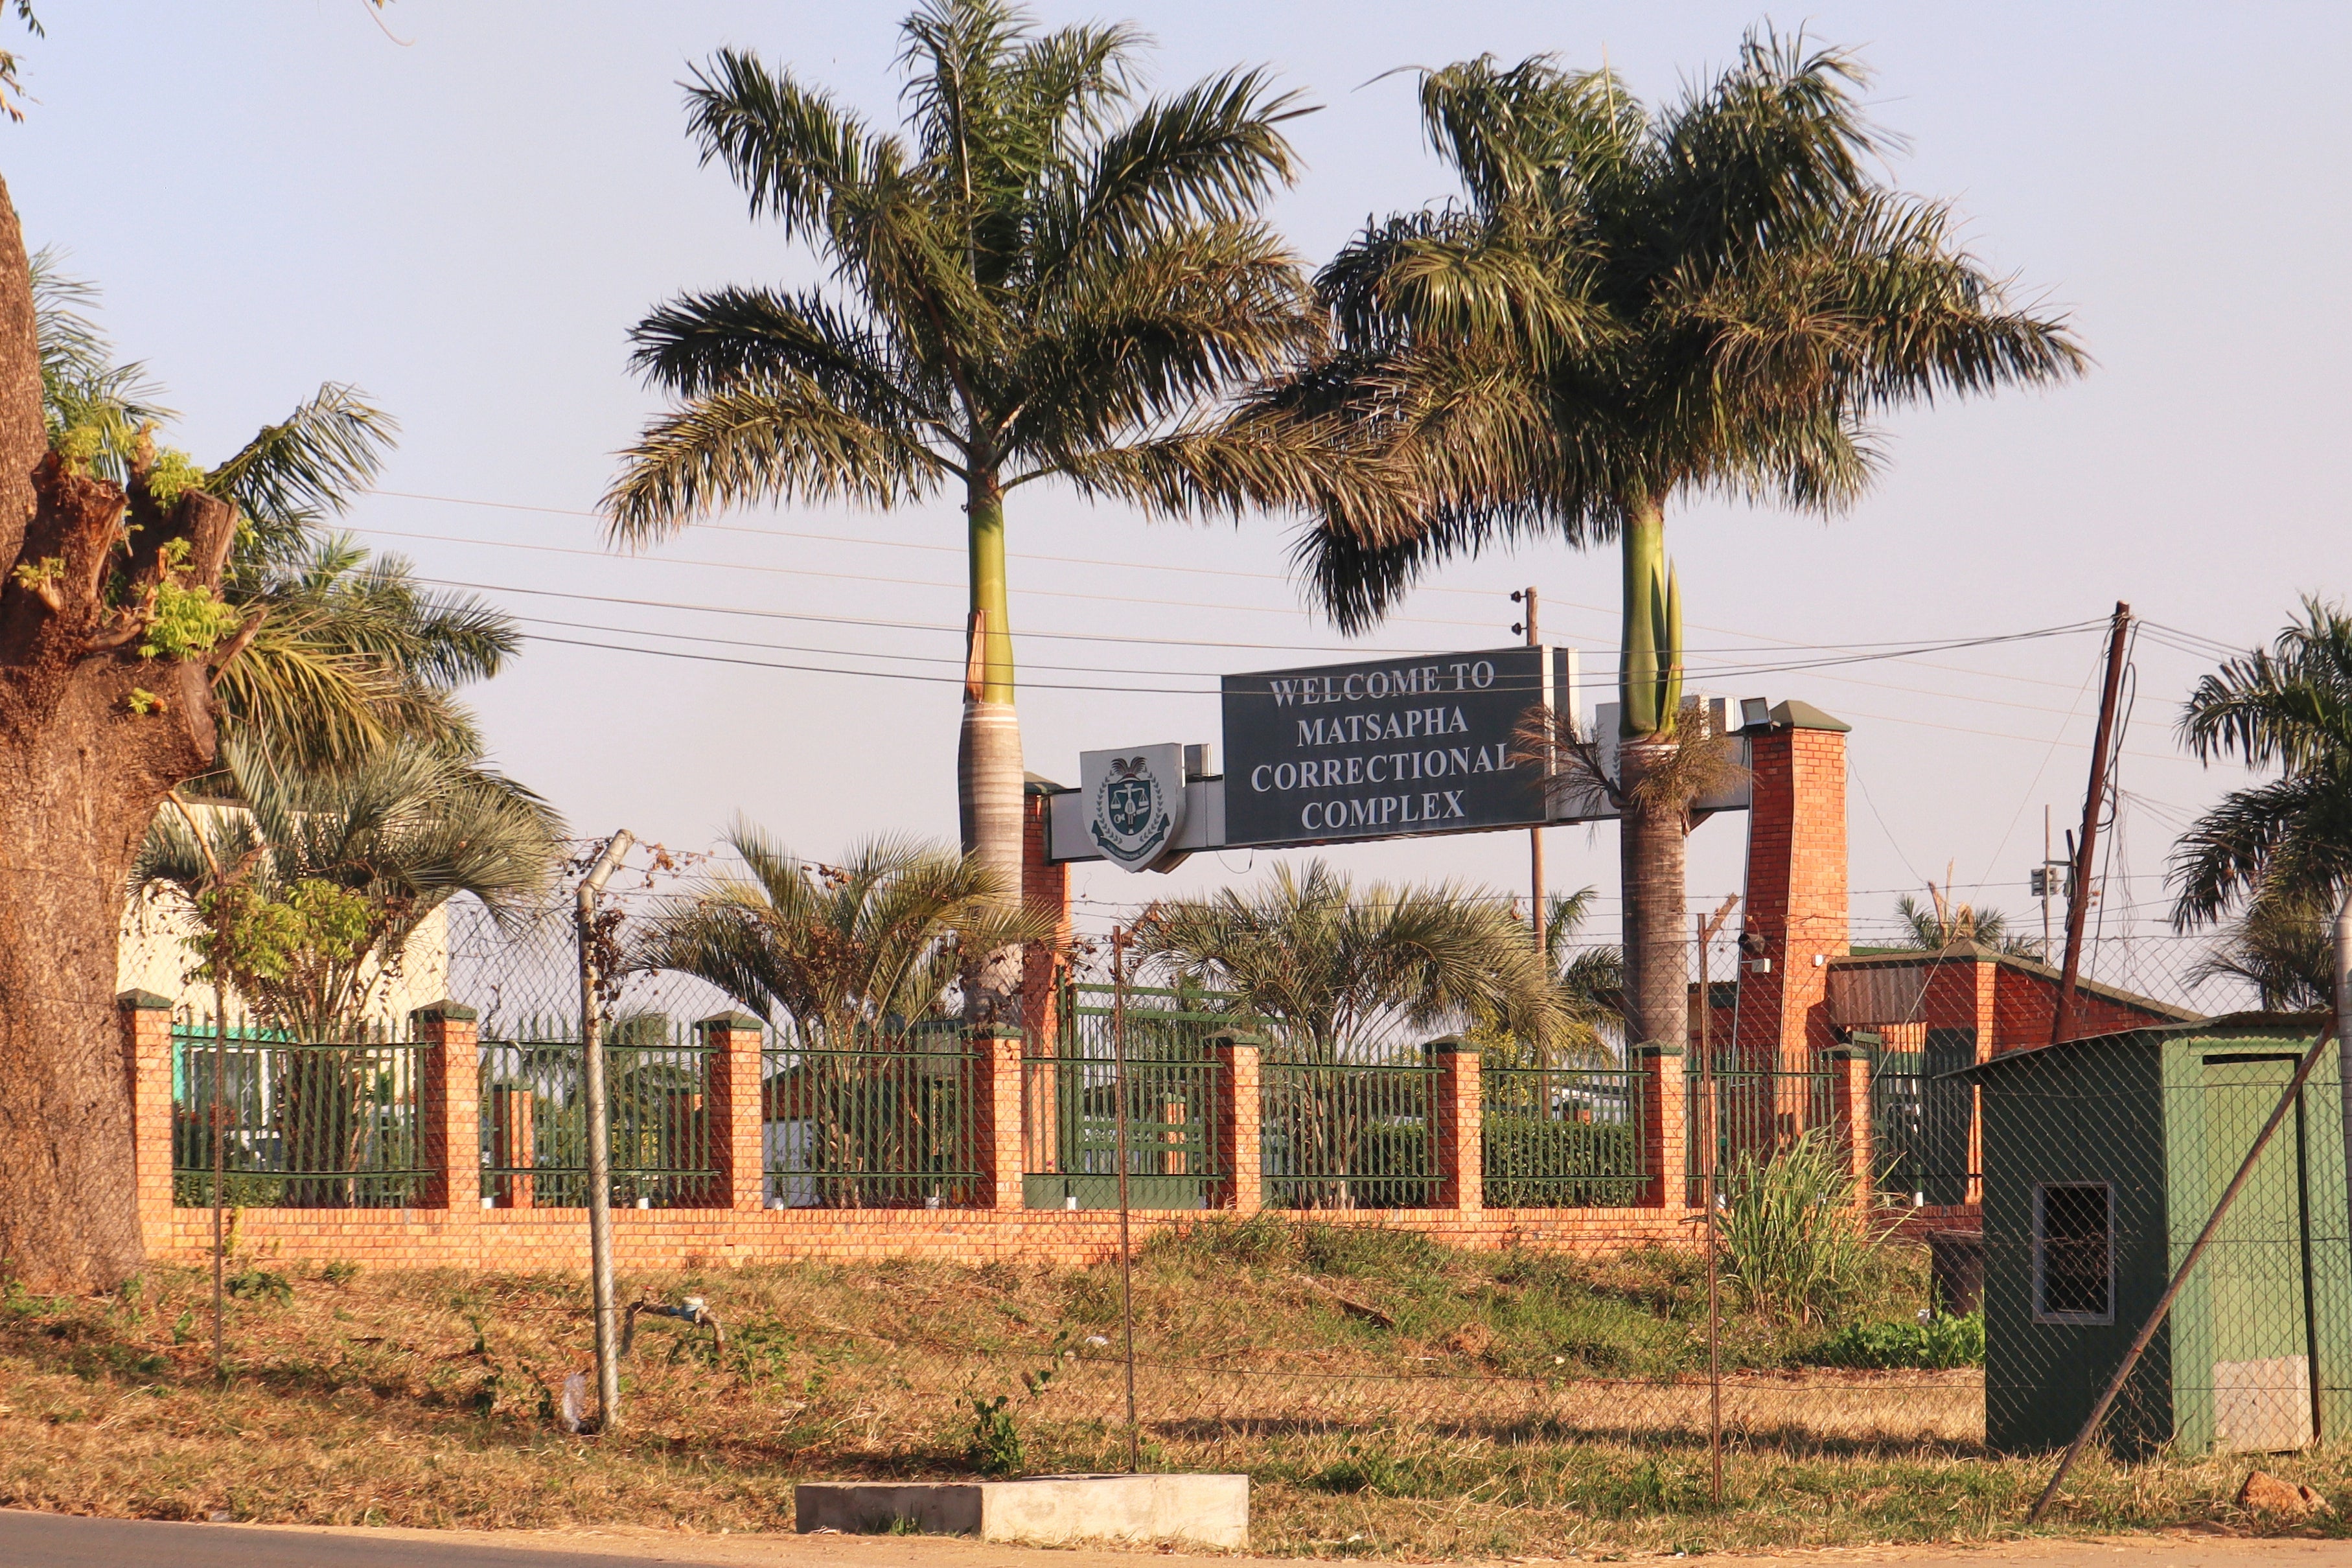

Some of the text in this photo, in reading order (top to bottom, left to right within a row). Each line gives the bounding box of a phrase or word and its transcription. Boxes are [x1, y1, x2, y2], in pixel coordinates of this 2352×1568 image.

[1269, 660, 1495, 708] WELCOME TO
[1297, 706, 1469, 747] MATSAPHA
[1251, 743, 1516, 792] CORRECTIONAL
[1301, 789, 1465, 830] COMPLEX
